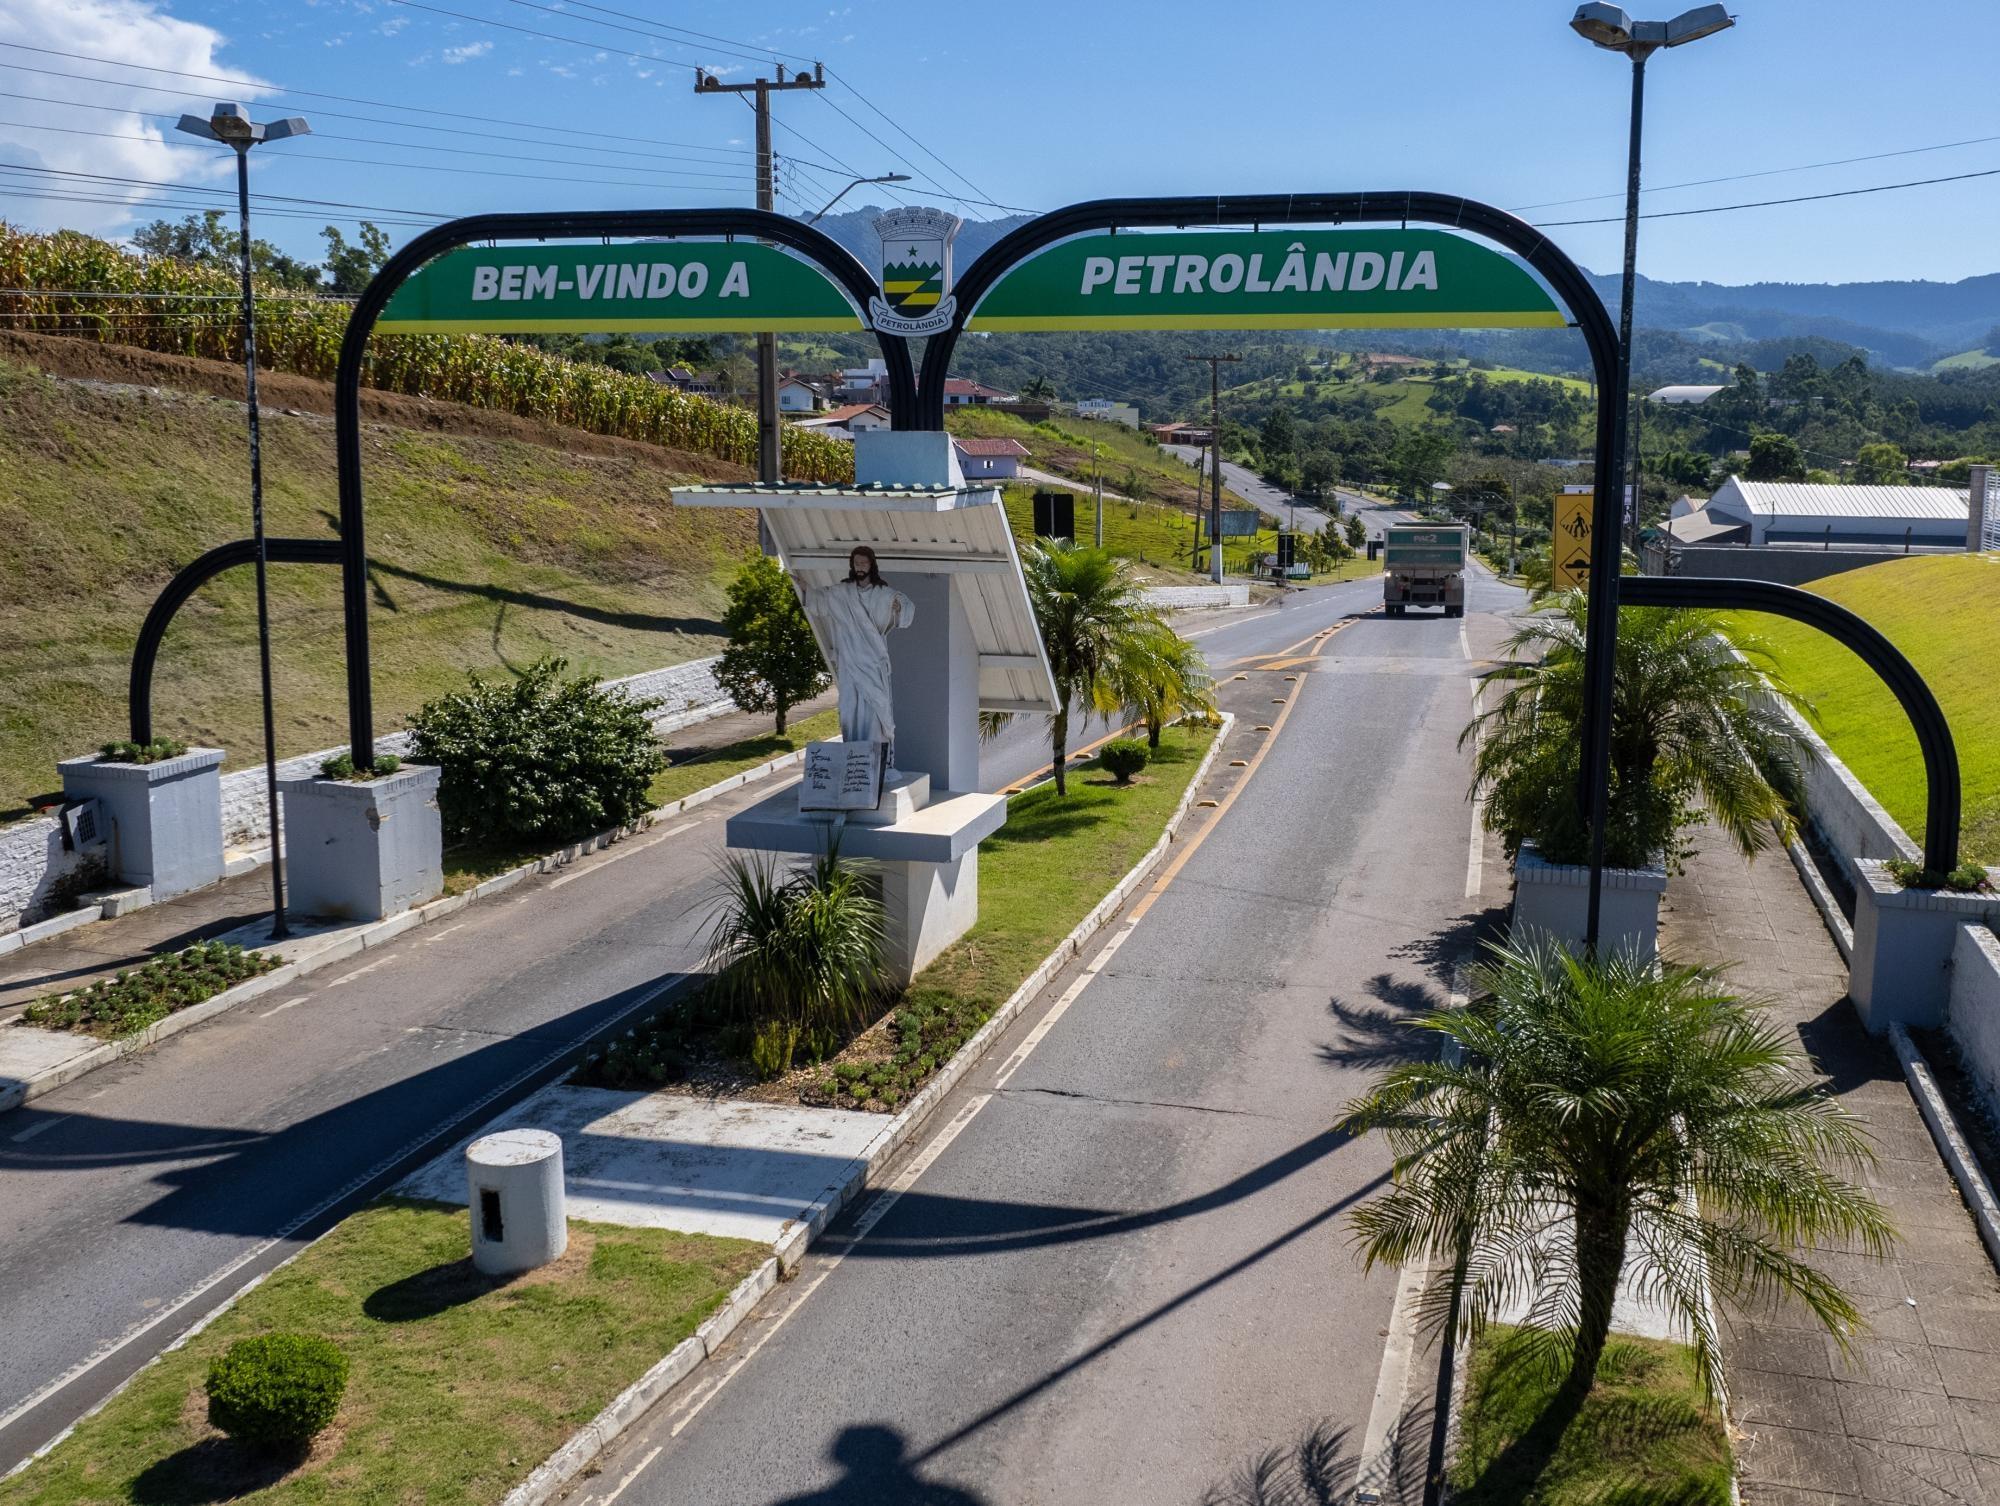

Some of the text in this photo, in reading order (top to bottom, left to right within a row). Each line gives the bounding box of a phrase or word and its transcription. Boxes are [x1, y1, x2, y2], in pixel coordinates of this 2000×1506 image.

[471, 261, 750, 301] BEM-VINDO A
[1080, 242, 1439, 295] PETROLÂNDIA
